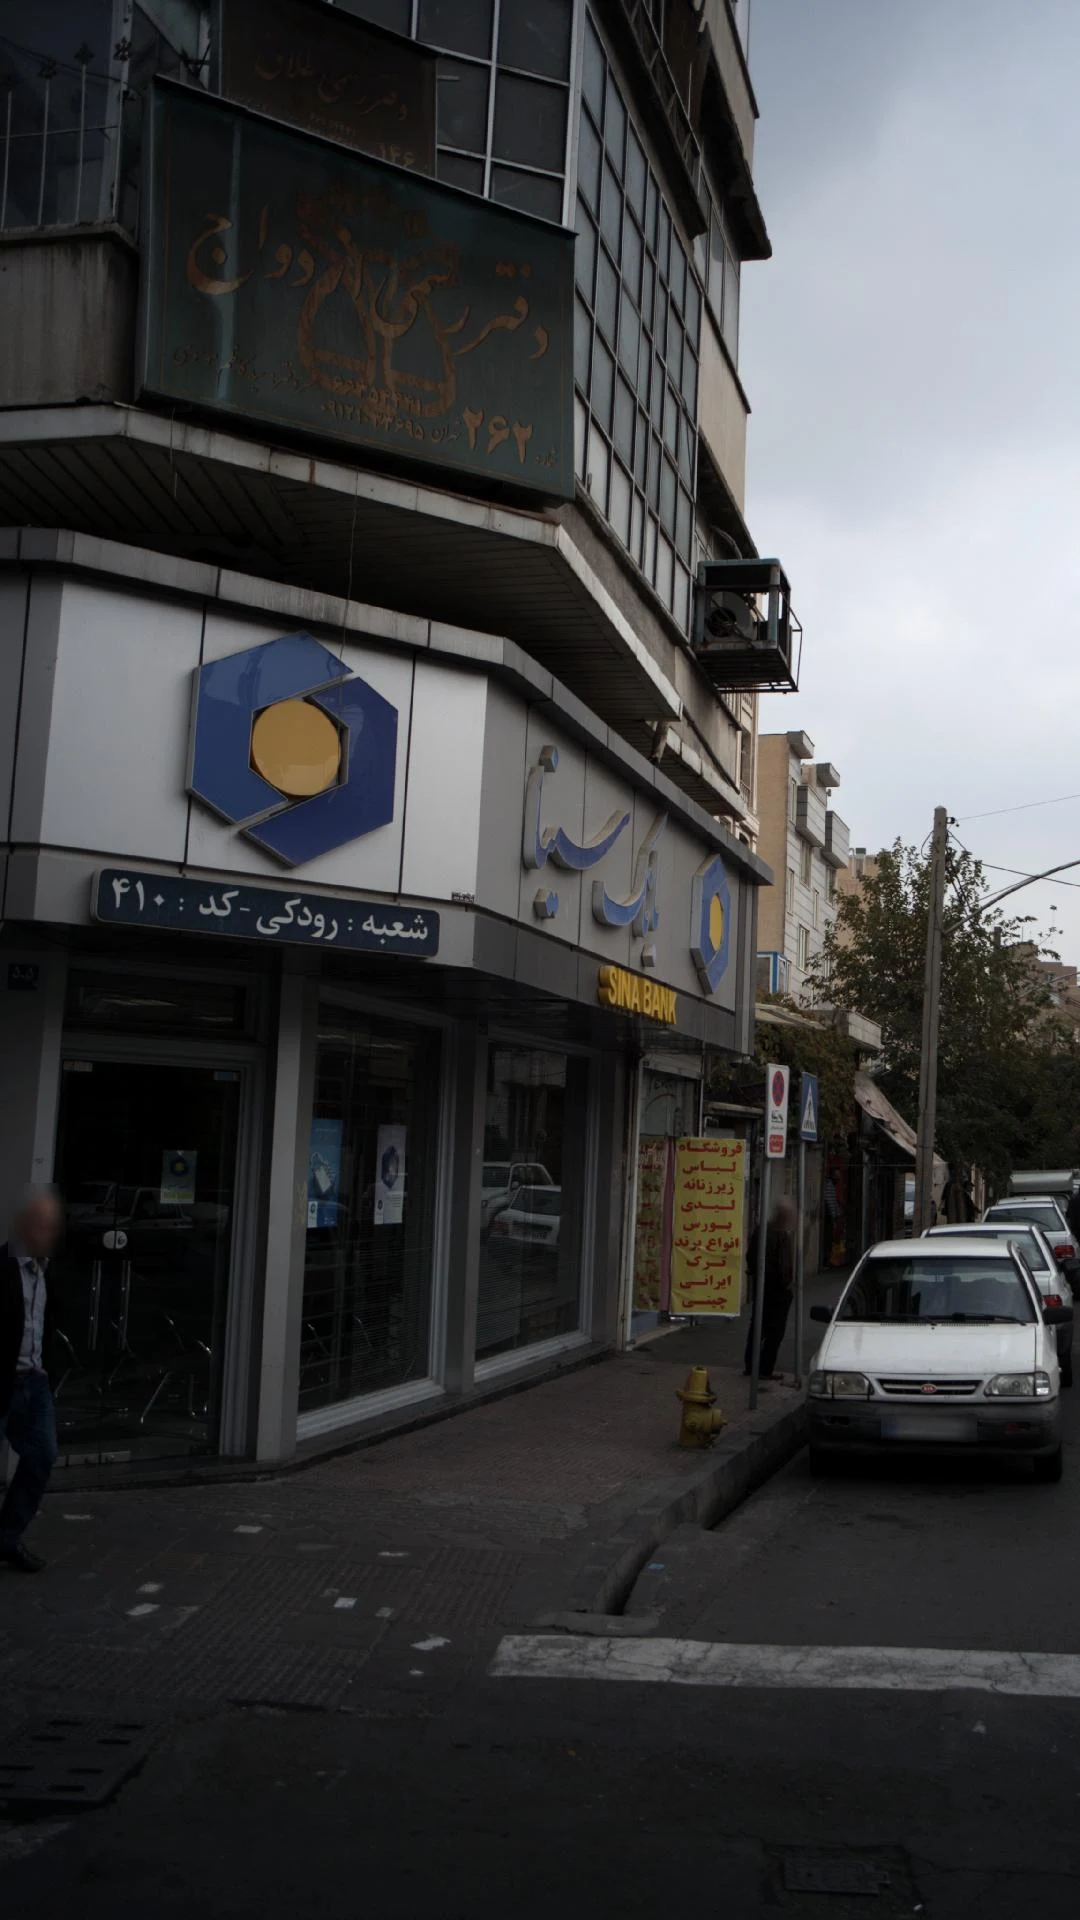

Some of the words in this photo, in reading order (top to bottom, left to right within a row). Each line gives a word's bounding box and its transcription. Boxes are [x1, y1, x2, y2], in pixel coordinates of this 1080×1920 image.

[360, 72, 410, 121] دفتر
[187, 203, 362, 299] ازدواج
[373, 253, 471, 338] رسمی
[454, 262, 549, 361] دفتر
[463, 406, 533, 464] ۲۶۲
[523, 745, 630, 919] سینا
[112, 877, 166, 912] ۴۱۰
[592, 809, 669, 968] بانک
[256, 898, 339, 941] رودکی
[598, 964, 642, 1013] SINA
[643, 980, 678, 1025] BANK
[679, 1142, 743, 1157] فروشگاه
[682, 1161, 736, 1175] لباس
[681, 1199, 735, 1213] لیدی
[683, 1219, 732, 1232] بورس
[674, 1238, 704, 1251] برند
[706, 1237, 739, 1252] انواع
[686, 1256, 726, 1270] ترک
[679, 1275, 732, 1290] ایرانی
[682, 1294, 728, 1309] چینی
